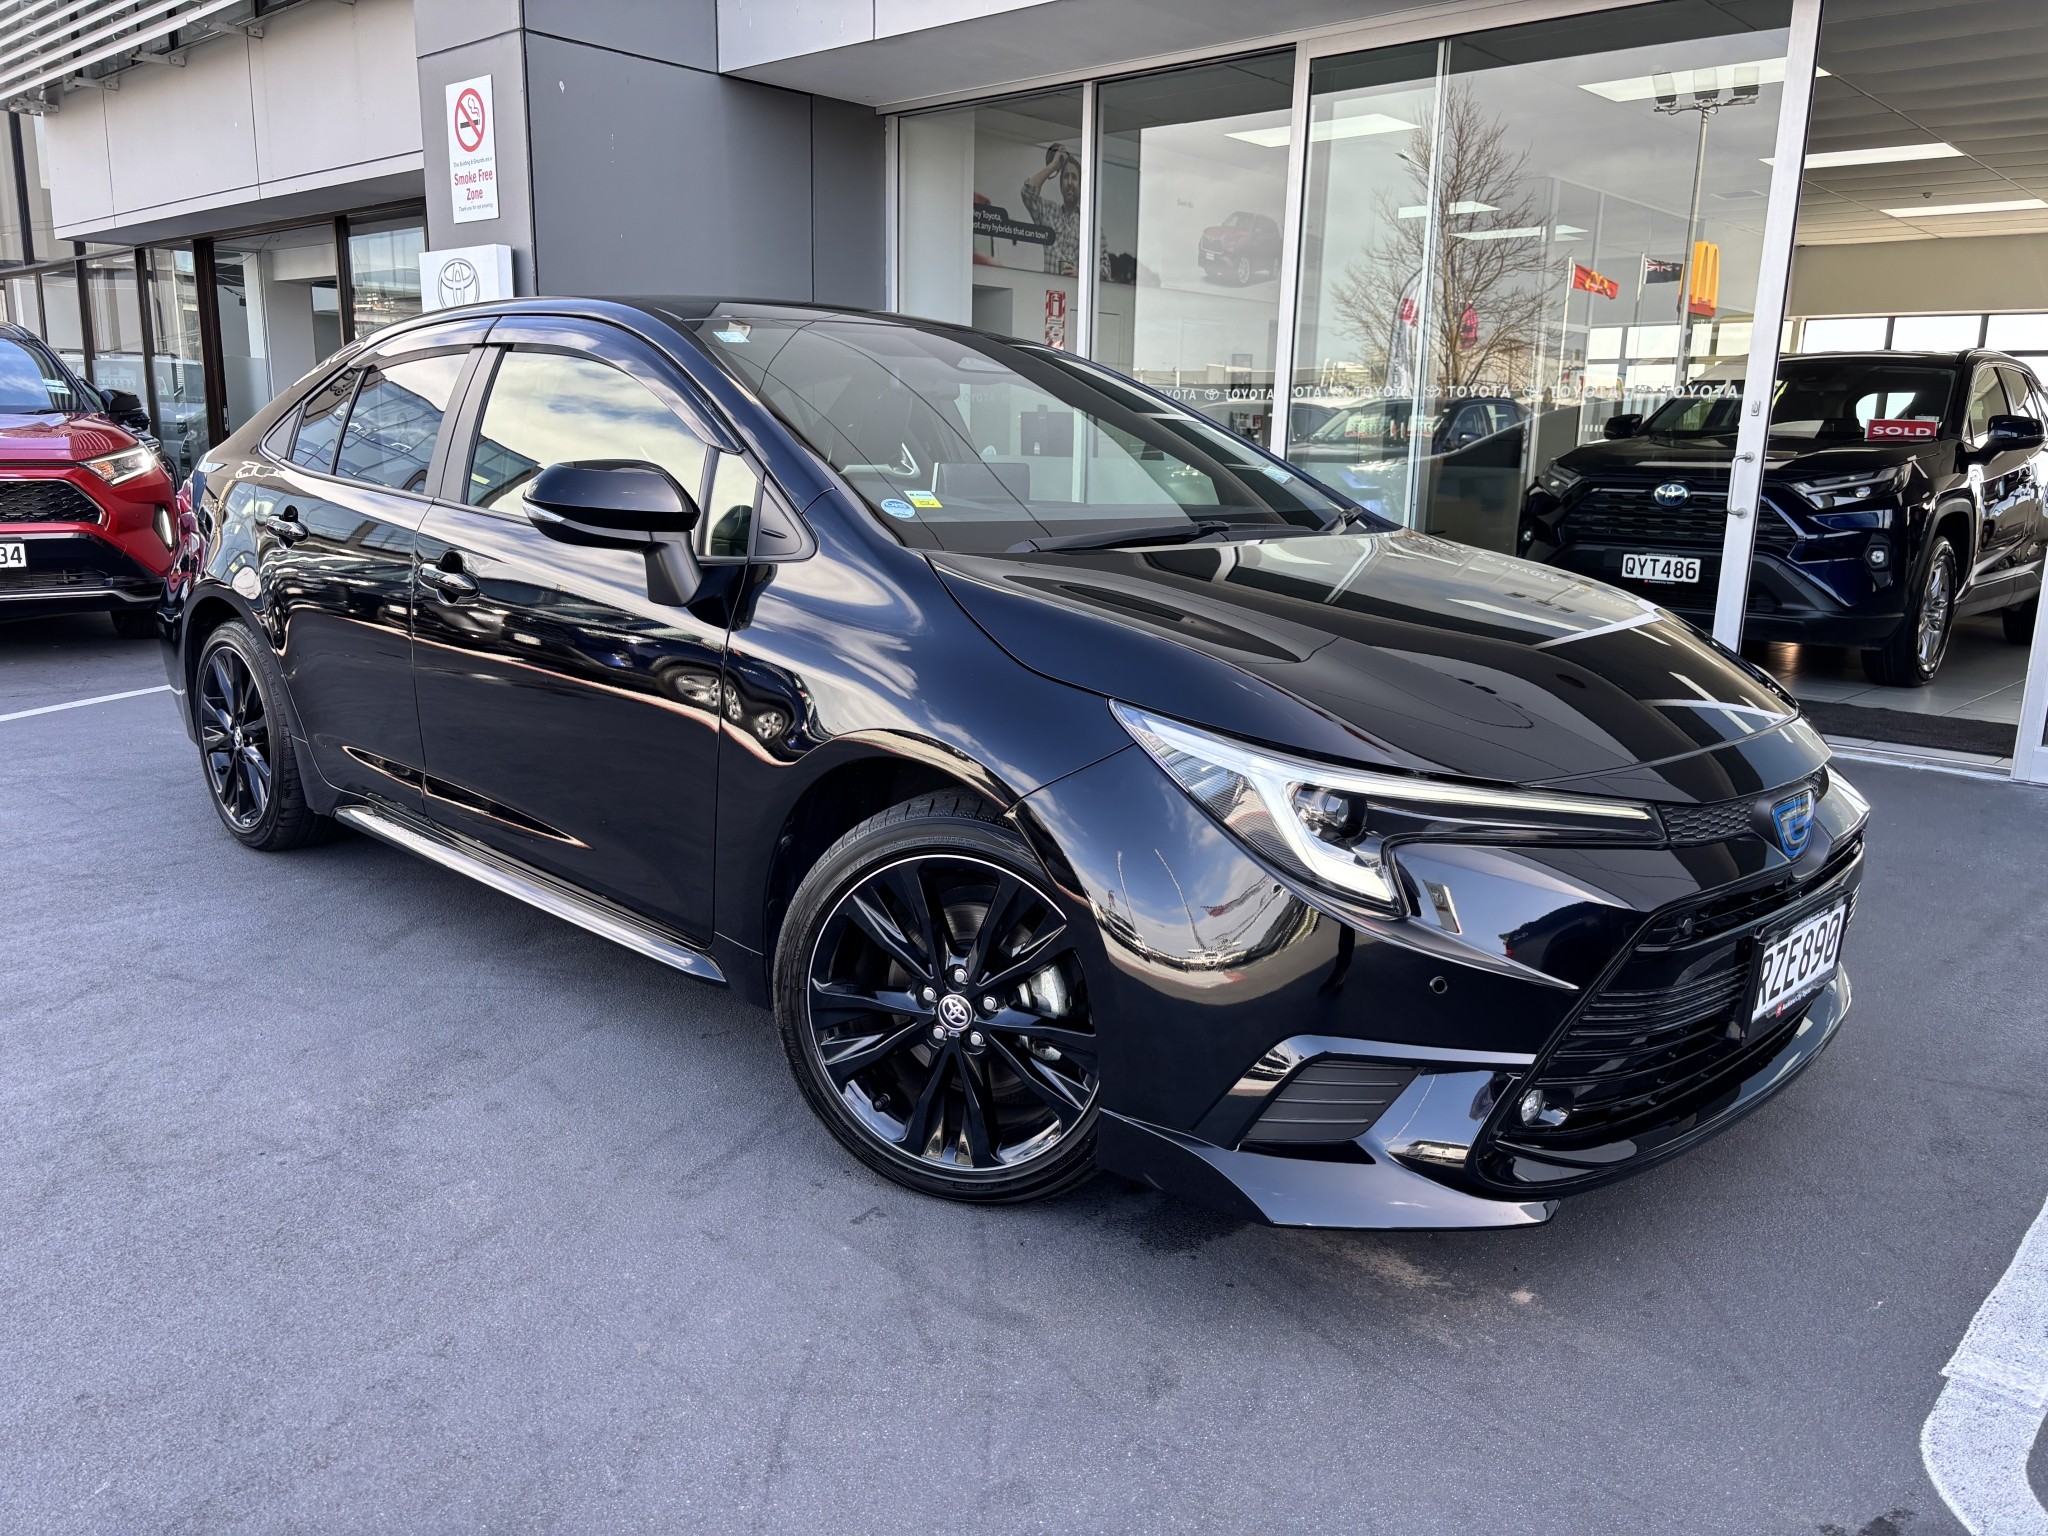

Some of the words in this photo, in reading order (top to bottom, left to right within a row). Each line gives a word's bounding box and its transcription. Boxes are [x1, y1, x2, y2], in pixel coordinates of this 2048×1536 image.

[454, 171, 477, 186] Smoke
[478, 169, 493, 182] Free
[466, 188, 484, 201] Zone
[973, 210, 981, 220] ey
[982, 210, 1002, 222] Toyota,
[981, 223, 991, 232] any
[992, 222, 1012, 234] hybrids
[1013, 226, 1024, 236] that
[1025, 230, 1034, 238] can
[1035, 230, 1048, 240] tow?
[1224, 389, 1274, 400] TOYOTA
[1355, 386, 1412, 399] TOYOTA
[1447, 385, 1511, 398] TOYOTA
[1551, 386, 1618, 399] TOYOTA
[1663, 384, 1738, 399] TOYOTA
[1872, 426, 1931, 436] SOLD
[1625, 556, 1697, 580] QYT486
[1753, 912, 1841, 1011] RZE890
